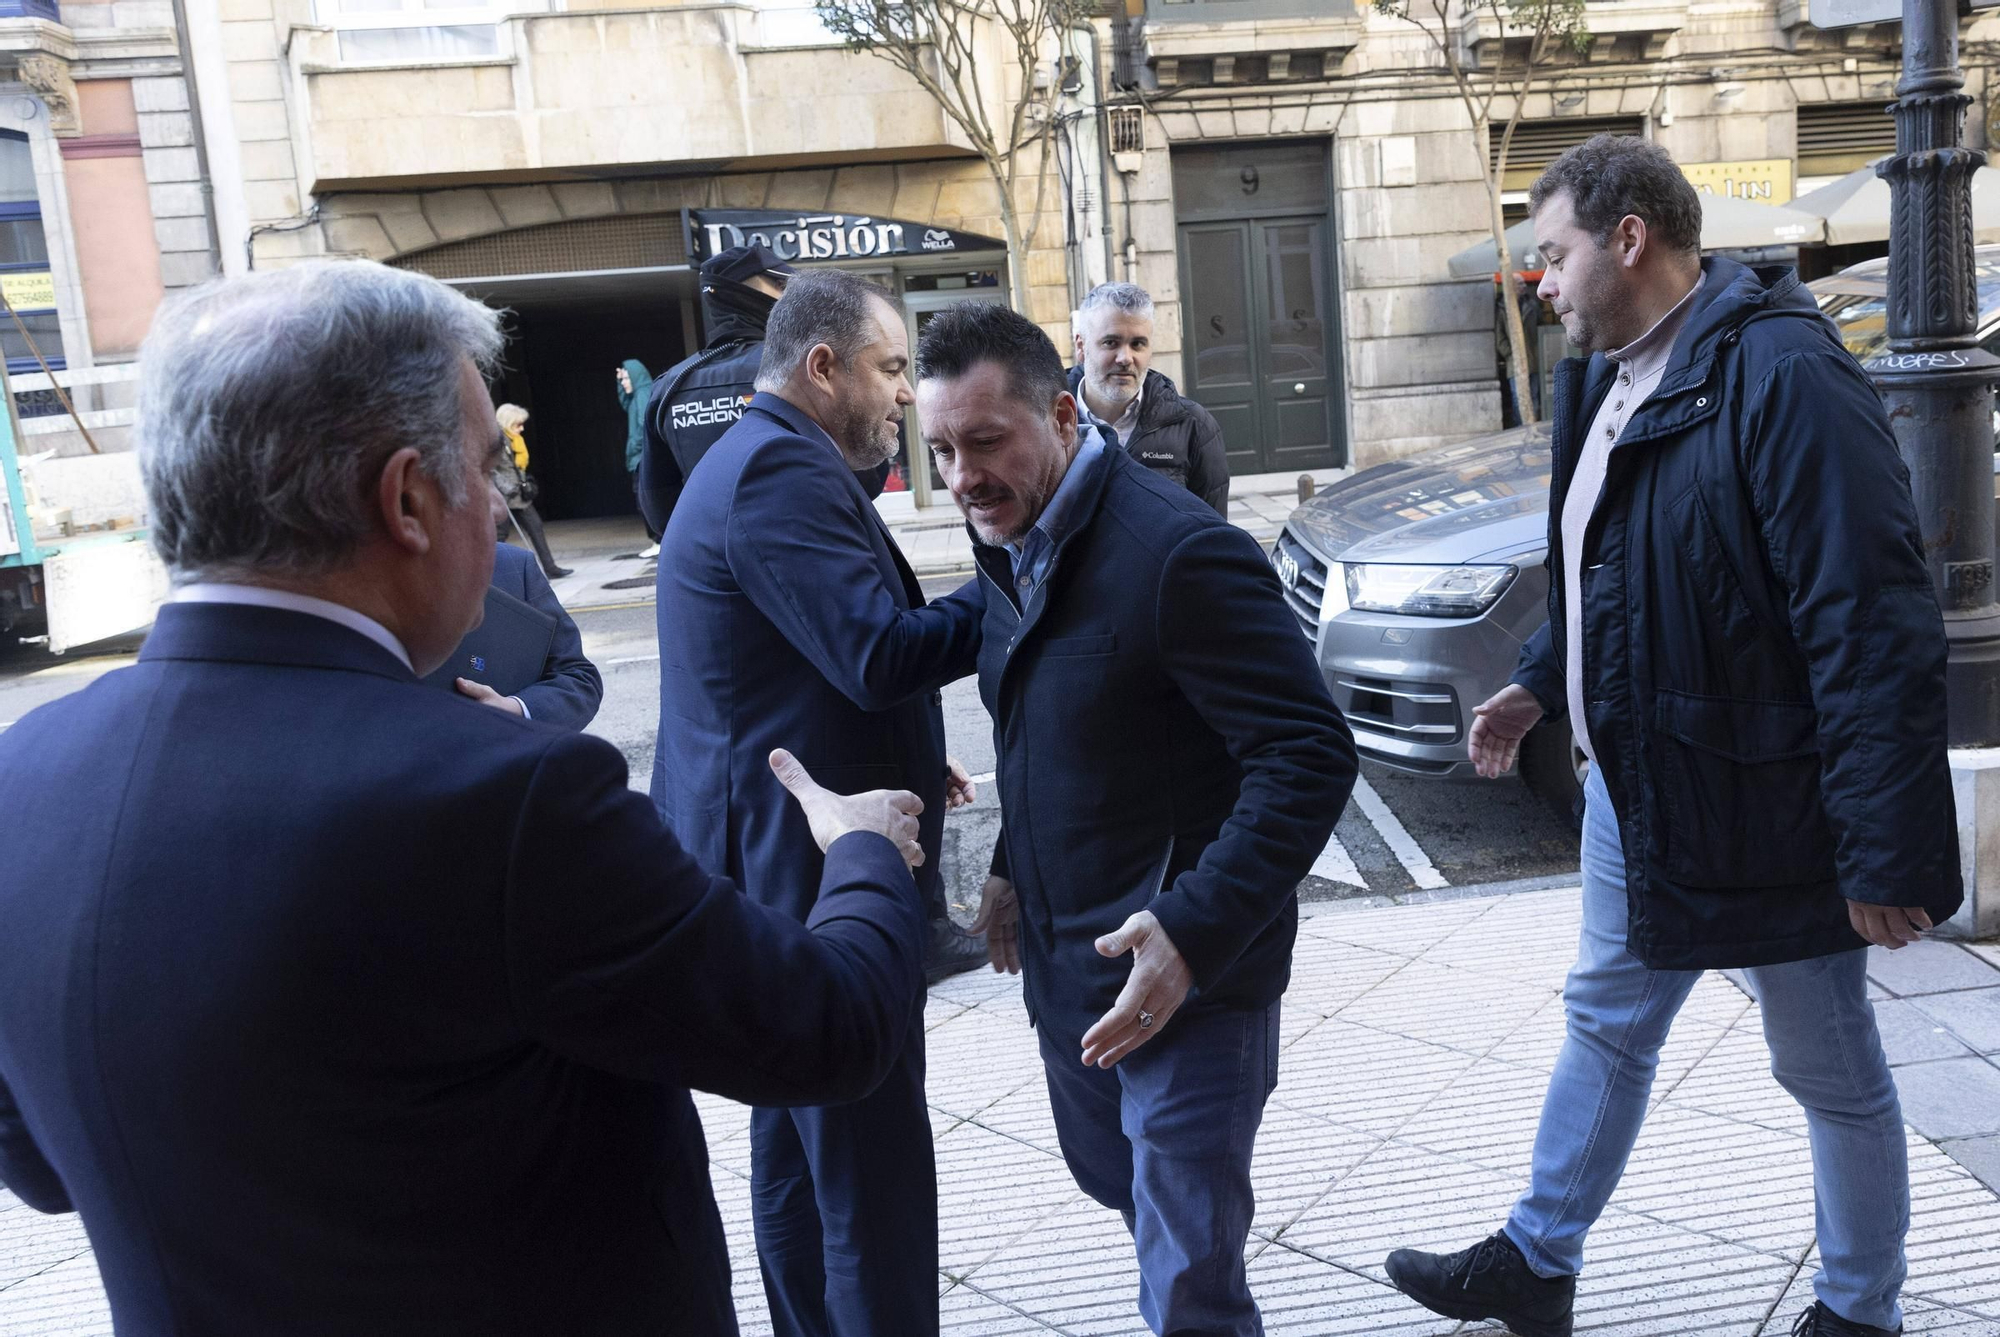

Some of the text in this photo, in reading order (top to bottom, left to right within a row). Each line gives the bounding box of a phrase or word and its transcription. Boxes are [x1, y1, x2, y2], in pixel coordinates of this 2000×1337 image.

[1240, 164, 1259, 196] 9
[921, 239, 956, 249] WELLA
[671, 395, 747, 417] POLICIA
[673, 408, 743, 429] NACION
